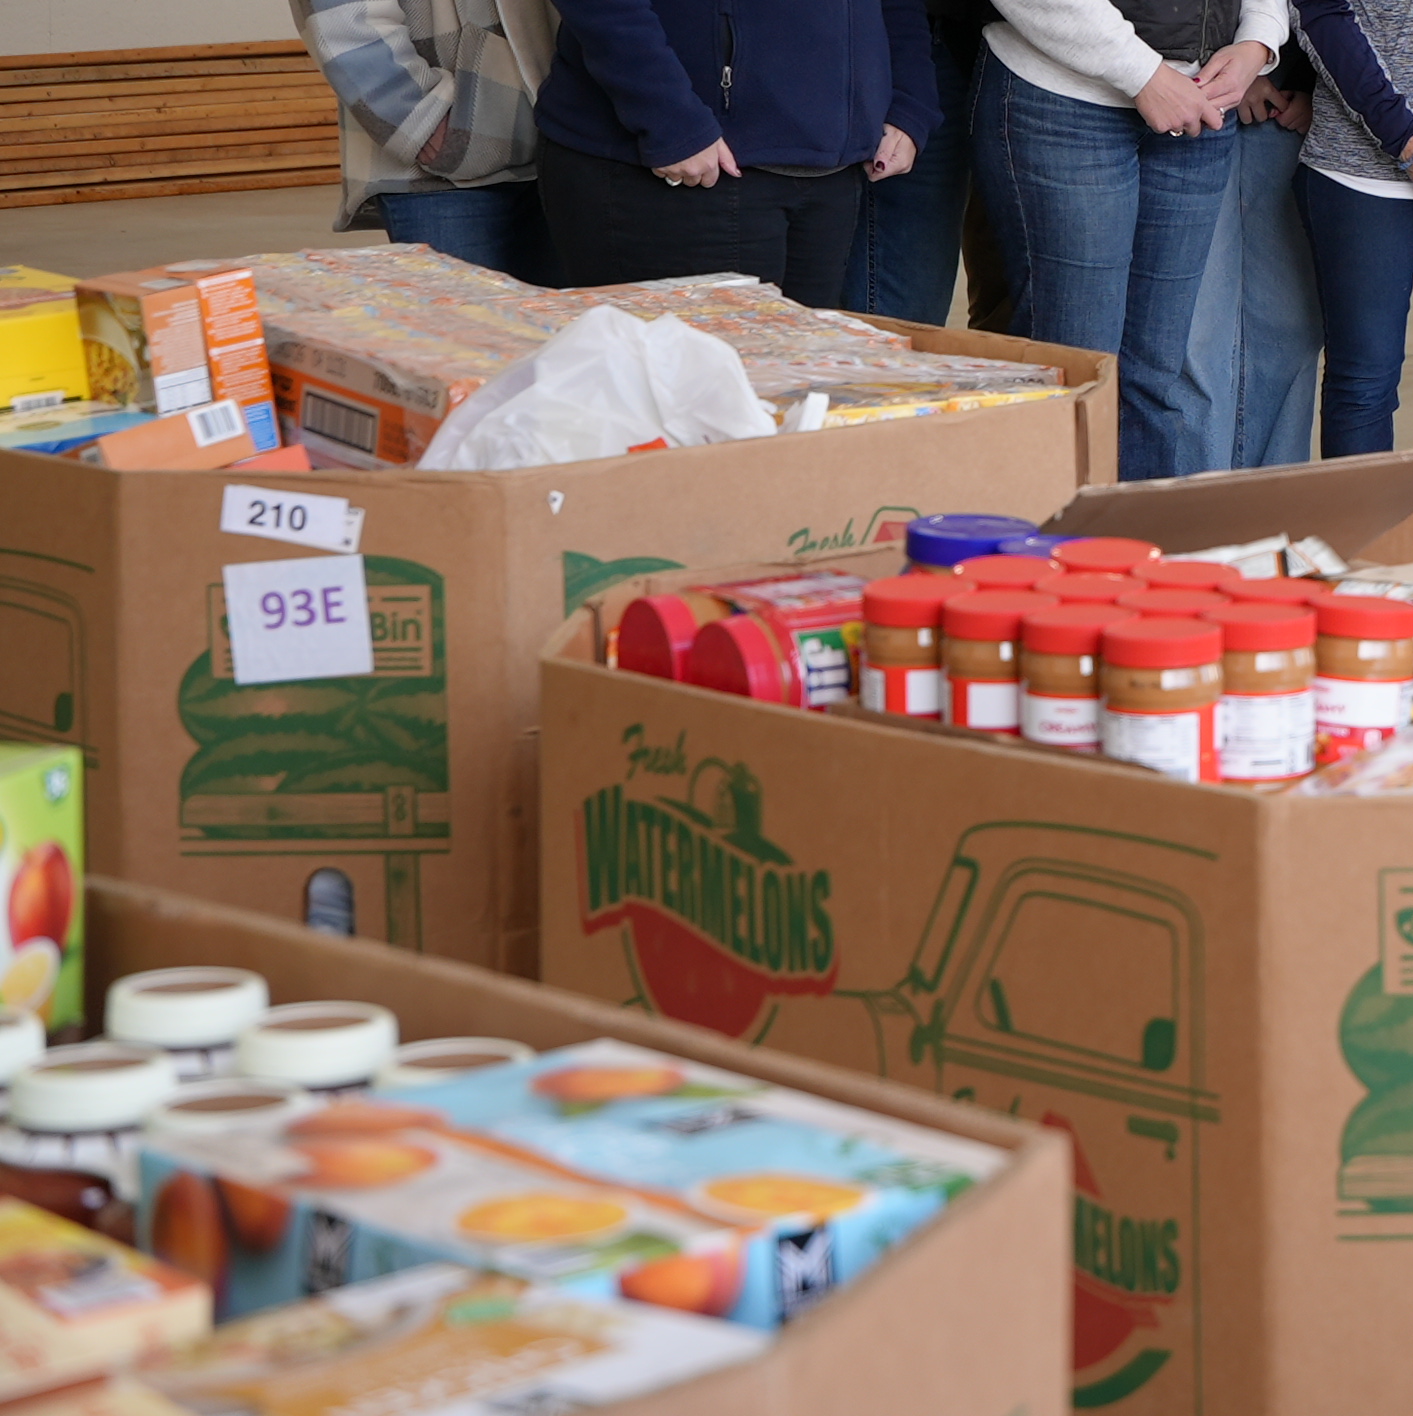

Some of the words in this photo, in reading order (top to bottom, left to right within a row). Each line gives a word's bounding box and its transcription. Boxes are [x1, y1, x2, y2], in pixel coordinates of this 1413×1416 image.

[248, 500, 308, 531] 210
[260, 586, 347, 630] 93E
[584, 783, 834, 973] WATERMELONS
